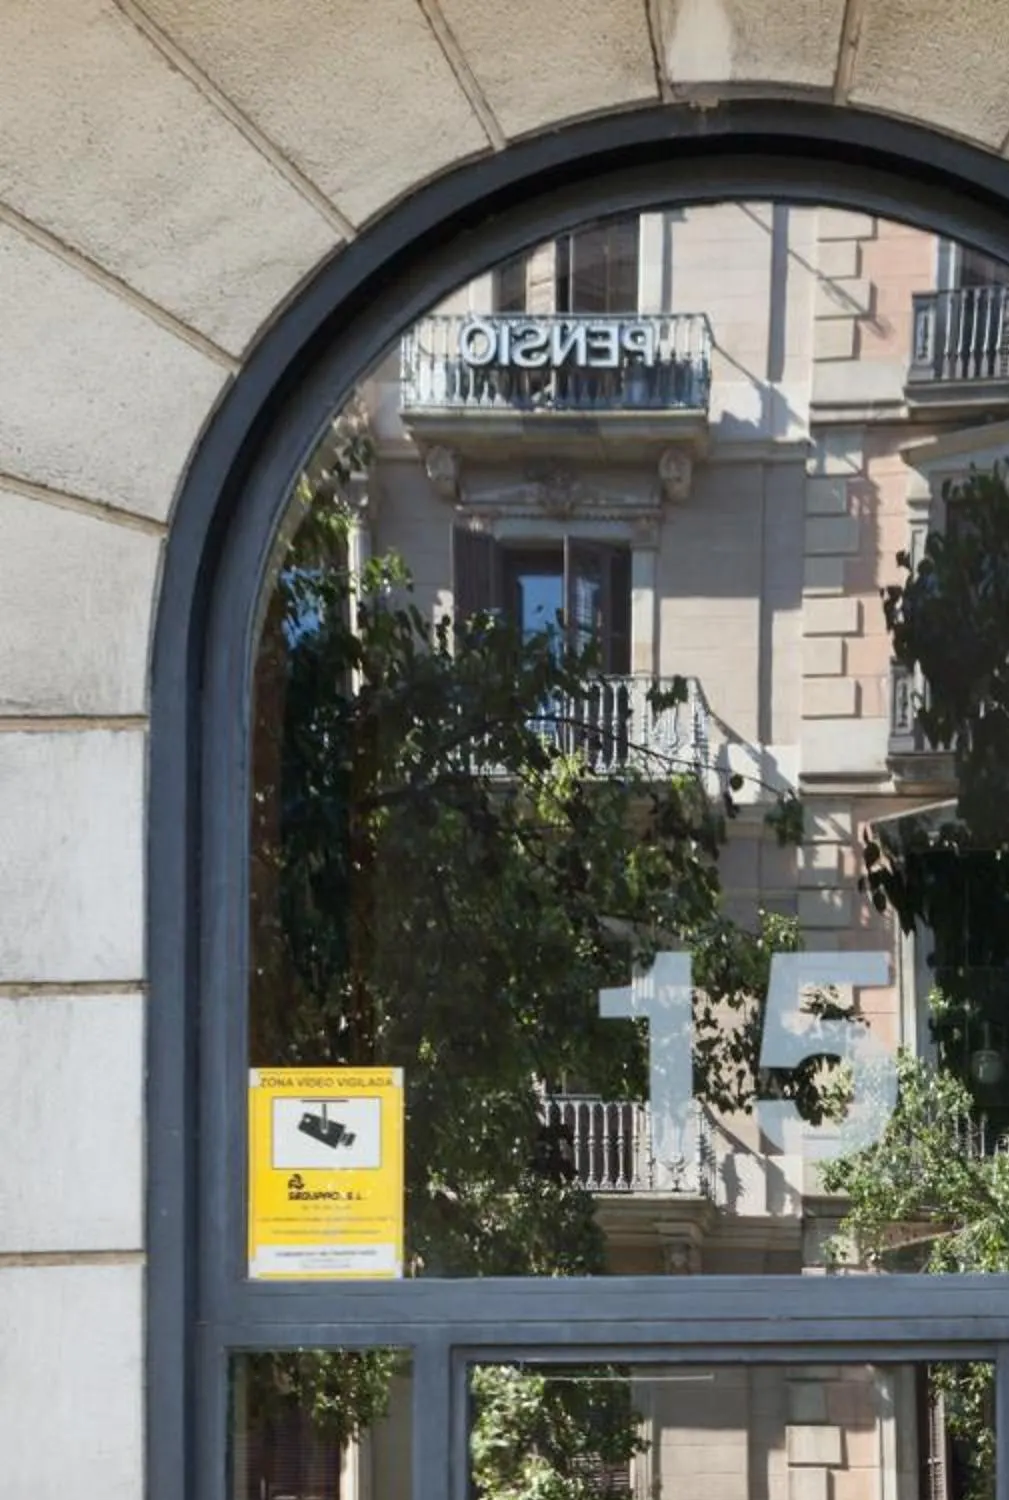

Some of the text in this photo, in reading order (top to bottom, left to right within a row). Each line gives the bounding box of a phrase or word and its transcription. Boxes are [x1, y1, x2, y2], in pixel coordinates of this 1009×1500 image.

[259, 1077, 294, 1088] ZONA
[297, 1077, 334, 1088] VIDEO
[600, 951, 898, 1163] 15
